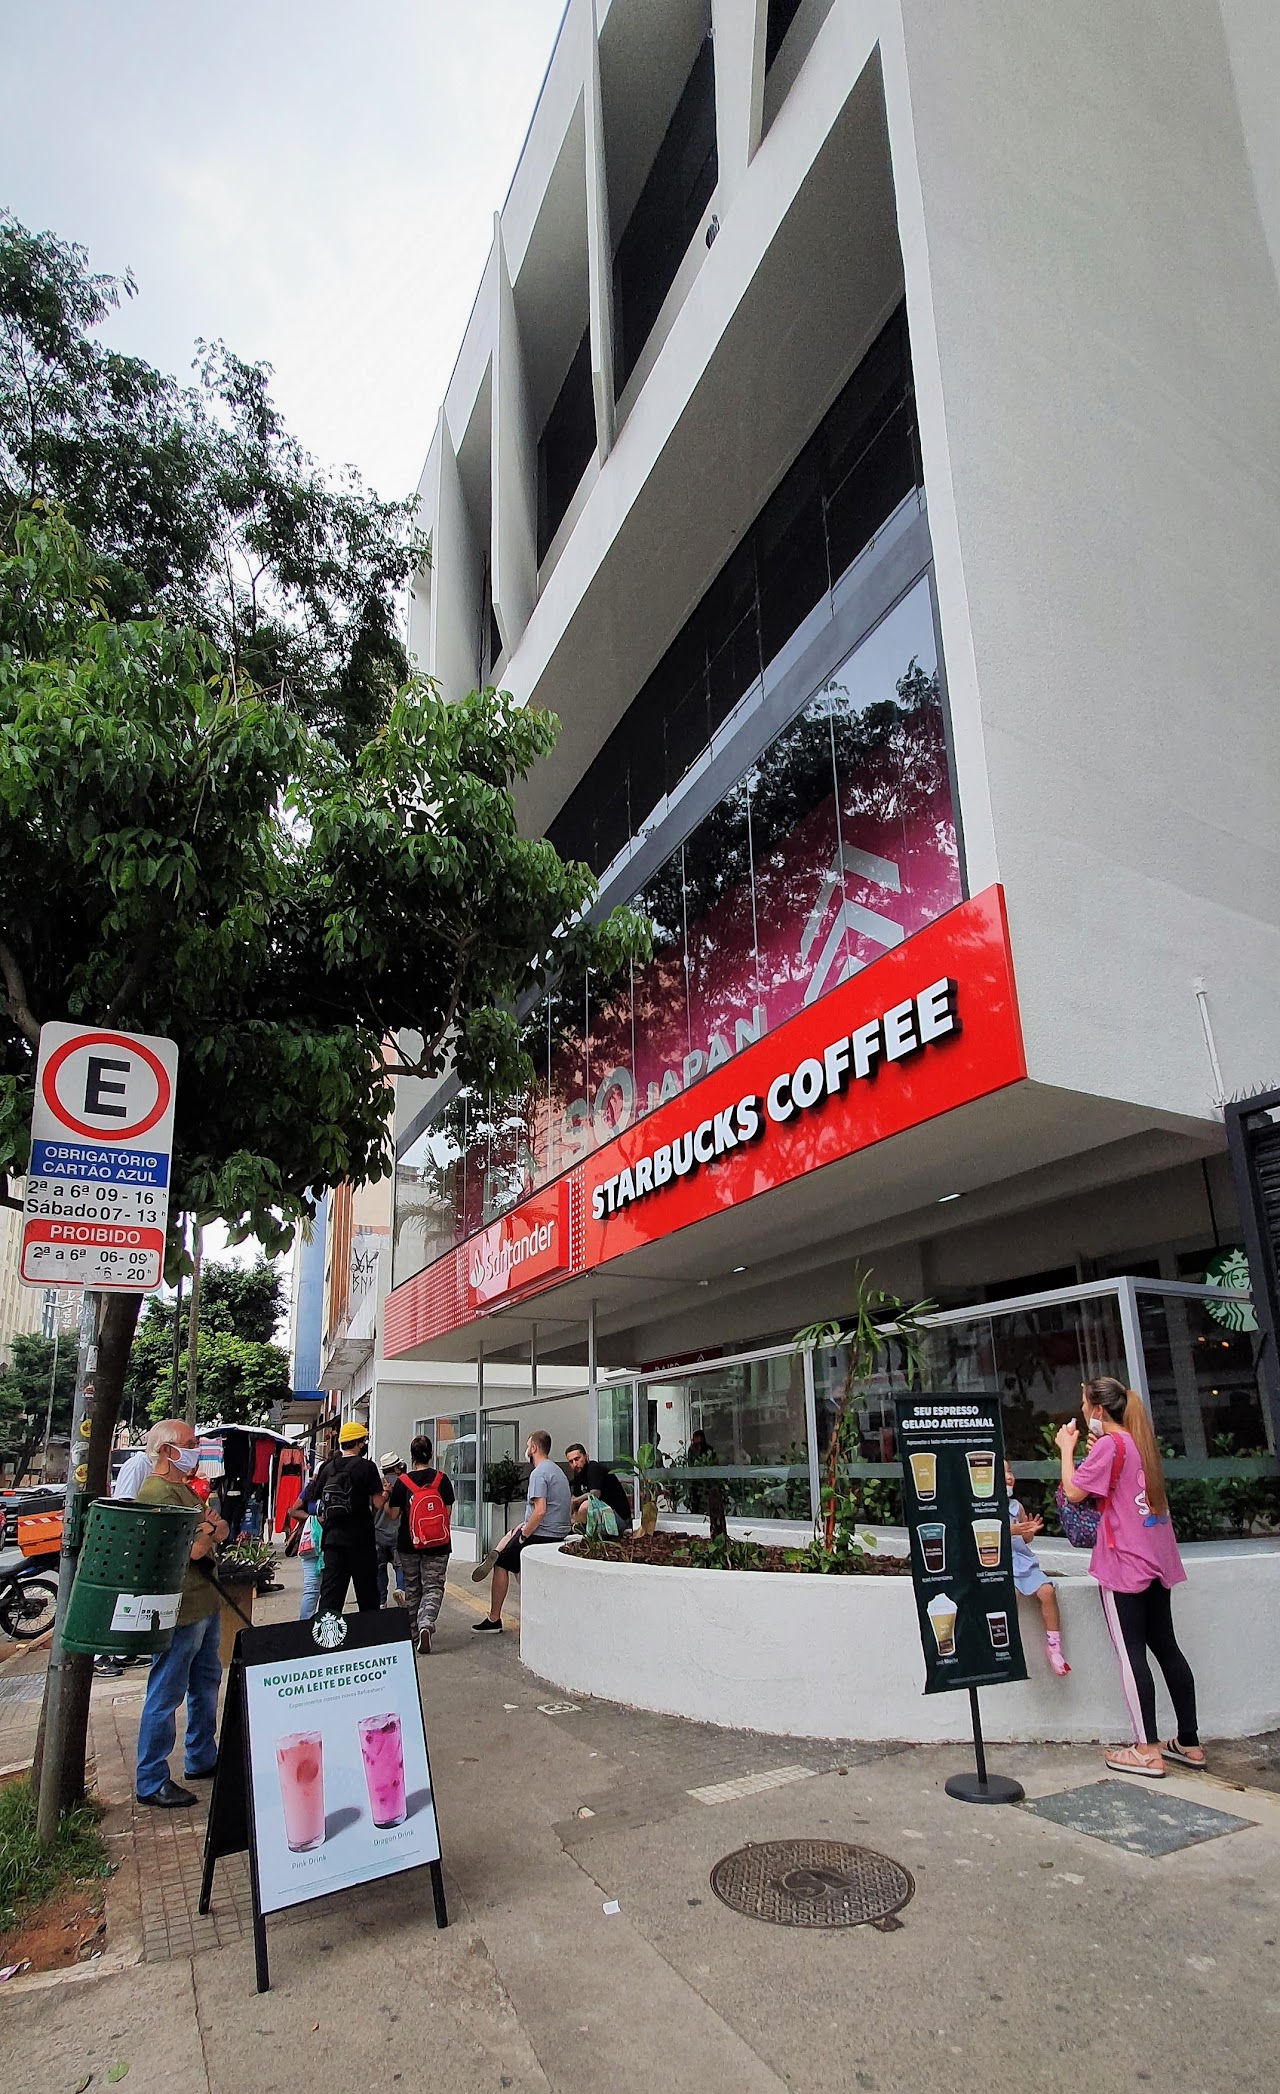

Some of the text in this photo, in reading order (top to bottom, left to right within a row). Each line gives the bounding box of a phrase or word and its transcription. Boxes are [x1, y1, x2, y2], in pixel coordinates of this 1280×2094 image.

[84, 1055, 131, 1118] E
[591, 976, 957, 1220] STARBUCKS COFFEE
[44, 1145, 158, 1169] OBRIGATÓRIO
[42, 1161, 157, 1184] CARTÃO AZUL
[53, 1186, 64, 1197] a
[95, 1187, 118, 1202] 09
[135, 1191, 154, 1205] 16
[26, 1198, 97, 1221] Sábado
[50, 1223, 141, 1245] PROIBIDO
[55, 1250, 65, 1260] a
[485, 1220, 555, 1281] Santander
[913, 1405, 979, 1416] SEU ESPRESSO
[902, 1417, 994, 1429] GELADO ARTESANAL
[263, 1654, 399, 1688] NOVIDADE REFRESCANTE
[278, 1683, 305, 1698] COM
[307, 1679, 336, 1695] LEITE
[337, 1677, 352, 1688] DE
[373, 1829, 415, 1847] Dragon Drink
[291, 1854, 327, 1870] Pink Drink
